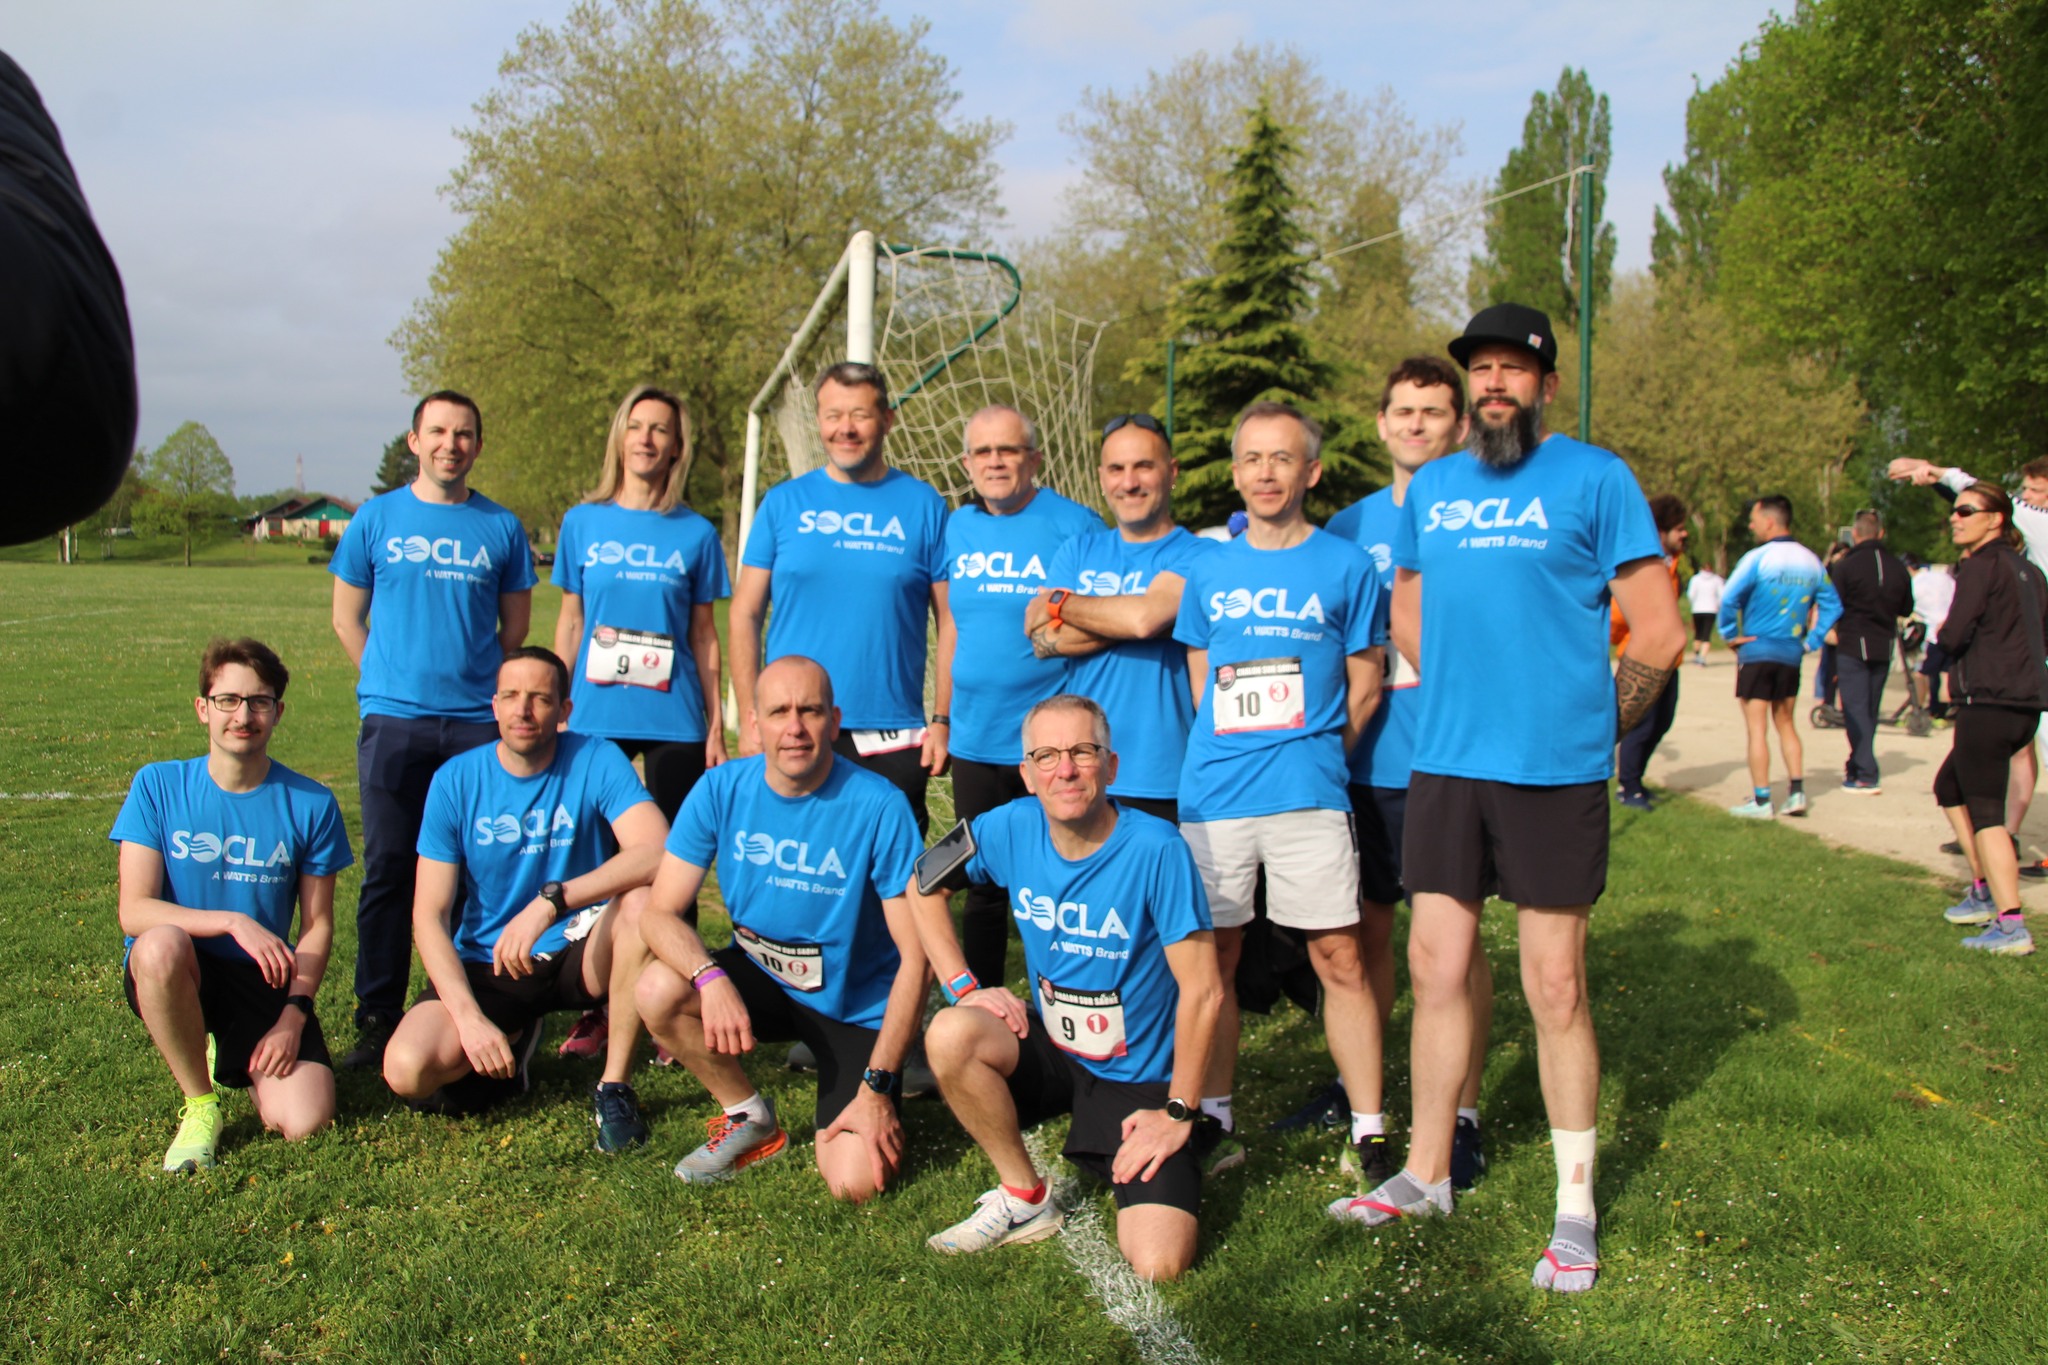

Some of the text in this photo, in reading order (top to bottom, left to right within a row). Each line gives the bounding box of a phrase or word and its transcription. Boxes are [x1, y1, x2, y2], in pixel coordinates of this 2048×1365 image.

[797, 509, 906, 541] SOCLA
[1423, 496, 1549, 533] SOCLA
[386, 535, 492, 570] SOCLA
[832, 539, 841, 548] A
[876, 541, 905, 555] Brand
[1457, 537, 1467, 549] A
[1507, 534, 1548, 550] Brand
[584, 540, 686, 575] SOCLA
[953, 551, 1047, 579] SOCLA
[425, 569, 432, 578] A
[1076, 569, 1147, 597] SOCL
[977, 583, 985, 593] A
[1015, 583, 1039, 595] Bra
[1209, 587, 1326, 624] SOCLA
[1242, 625, 1252, 636] A
[1290, 628, 1324, 641] Brand
[616, 652, 656, 675] 9 2
[1234, 681, 1286, 717] 10 3
[171, 829, 292, 868] SOCLA
[733, 829, 847, 879] SOCLA
[212, 871, 220, 881] A
[223, 871, 258, 883] WATTS
[765, 875, 847, 897] A WATTS Brand
[1013, 886, 1130, 940] SOCLA
[1049, 940, 1130, 960] A WATTS Brand
[758, 952, 805, 976] 10 6
[1061, 1014, 1101, 1041] 9 1
